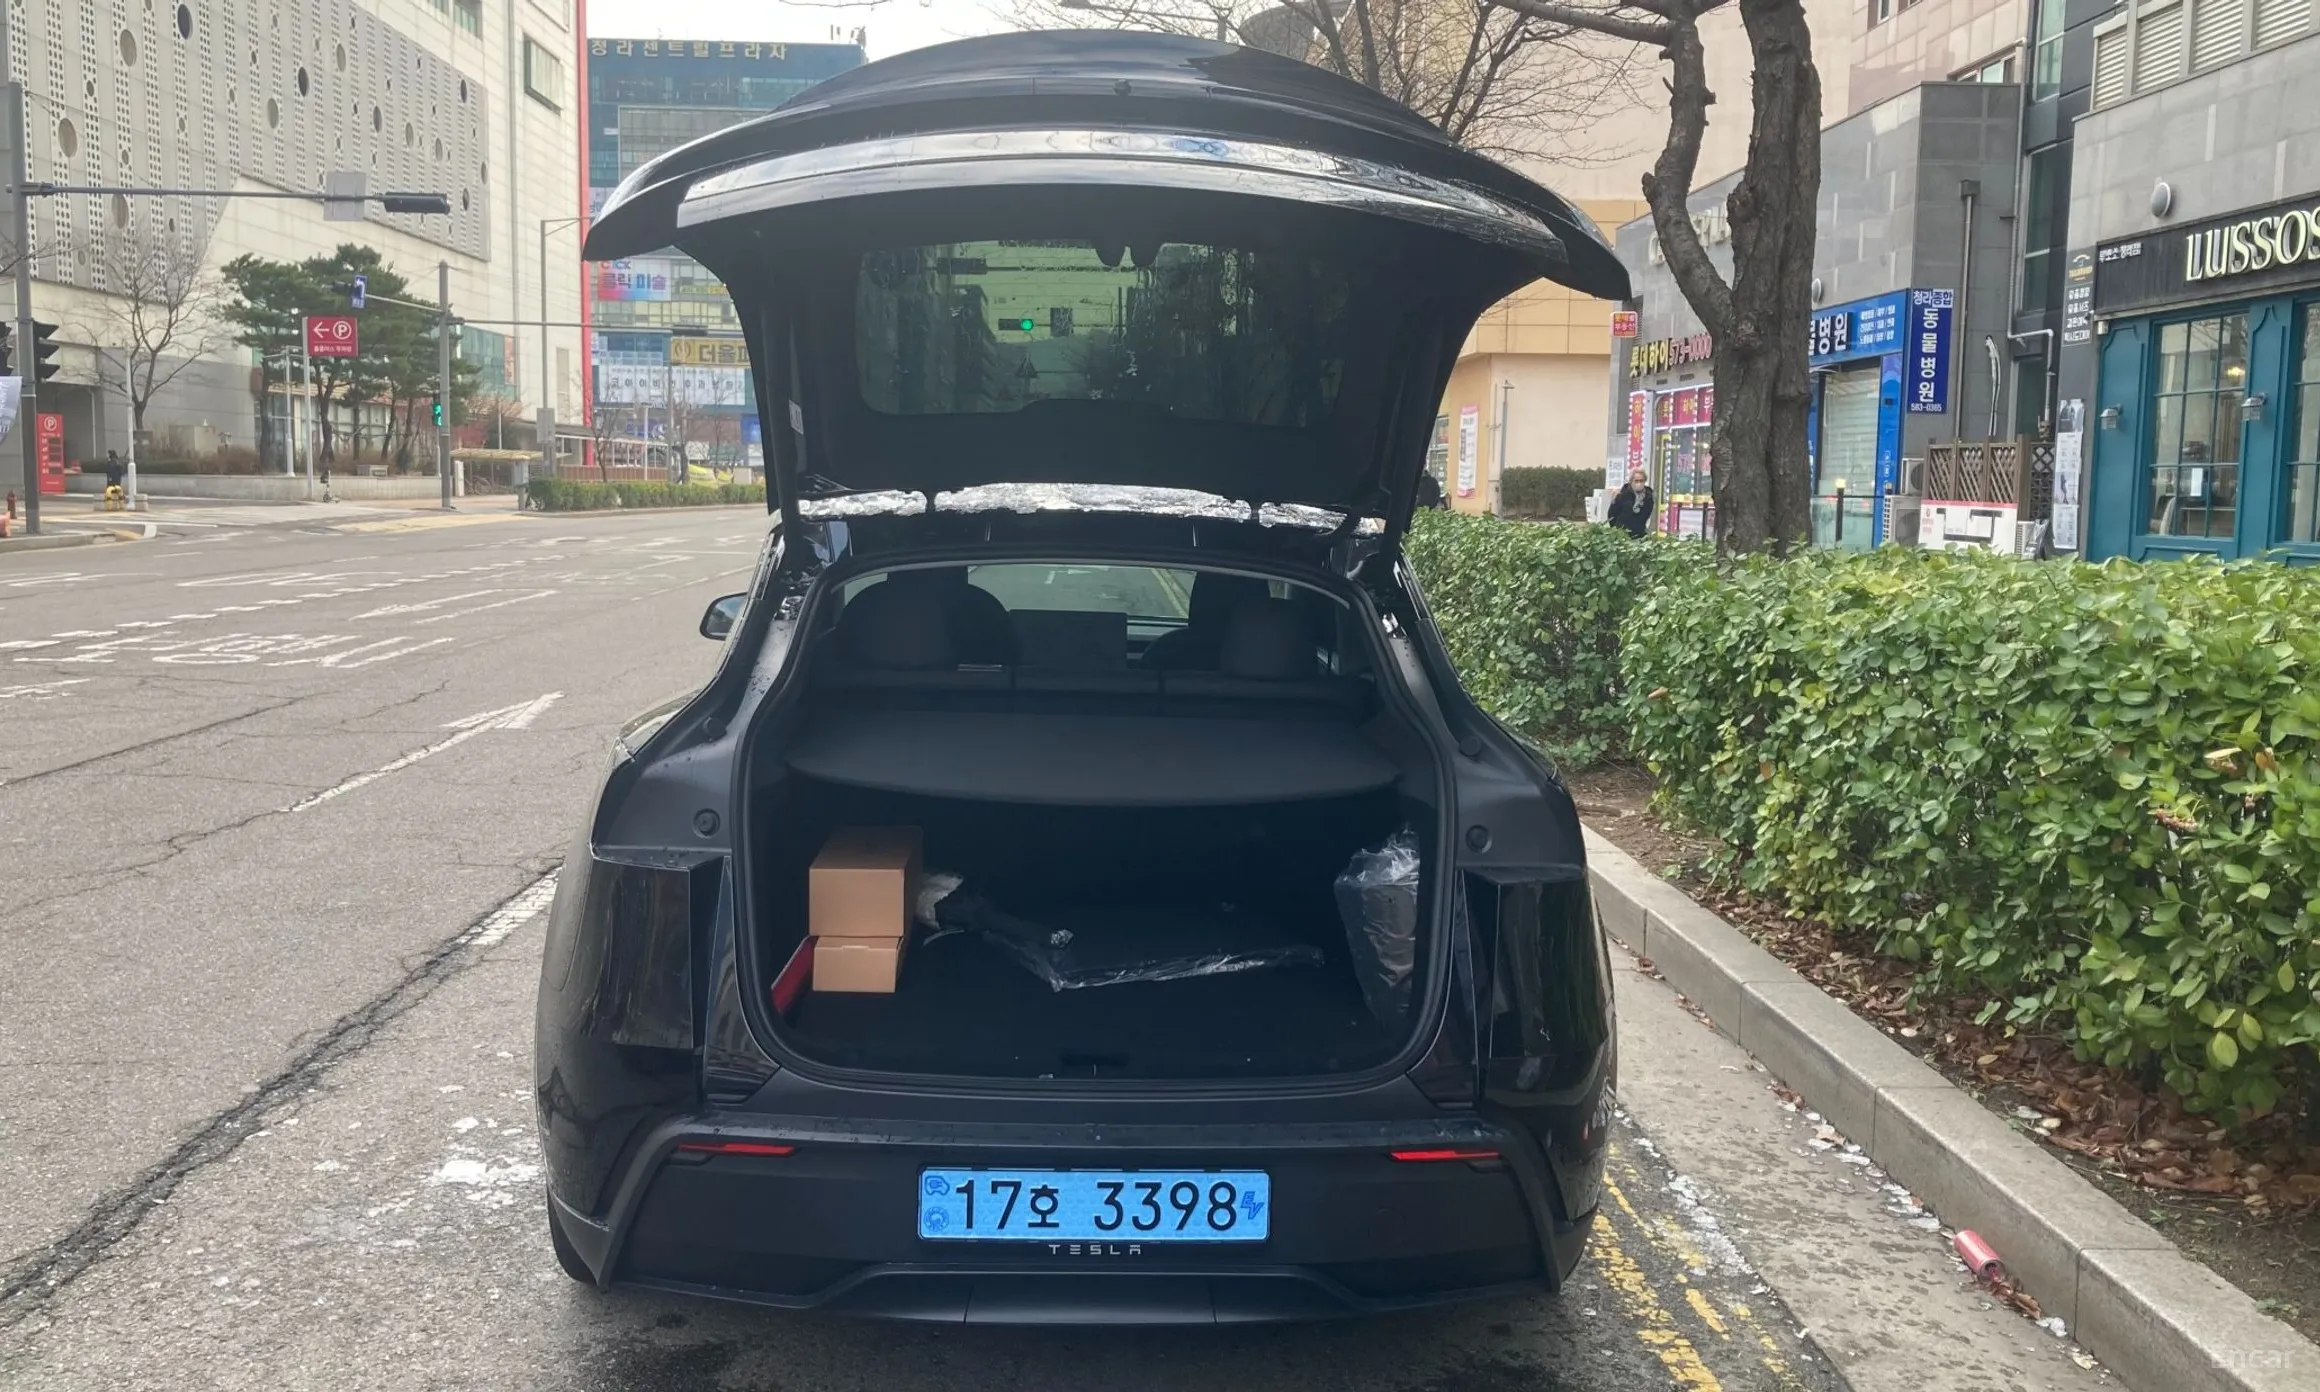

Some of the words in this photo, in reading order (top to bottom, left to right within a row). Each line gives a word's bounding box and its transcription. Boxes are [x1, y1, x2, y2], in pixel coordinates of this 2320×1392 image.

[603, 273, 631, 288] 클릭
[636, 273, 667, 290] 미술
[1629, 340, 1669, 378] 롯데하이
[1919, 308, 1938, 402] 동물병원
[955, 1179, 1060, 1230] 17호
[1093, 1181, 1237, 1231] 3398
[1240, 1190, 1263, 1220] EV
[1049, 1244, 1141, 1255] TESLA
